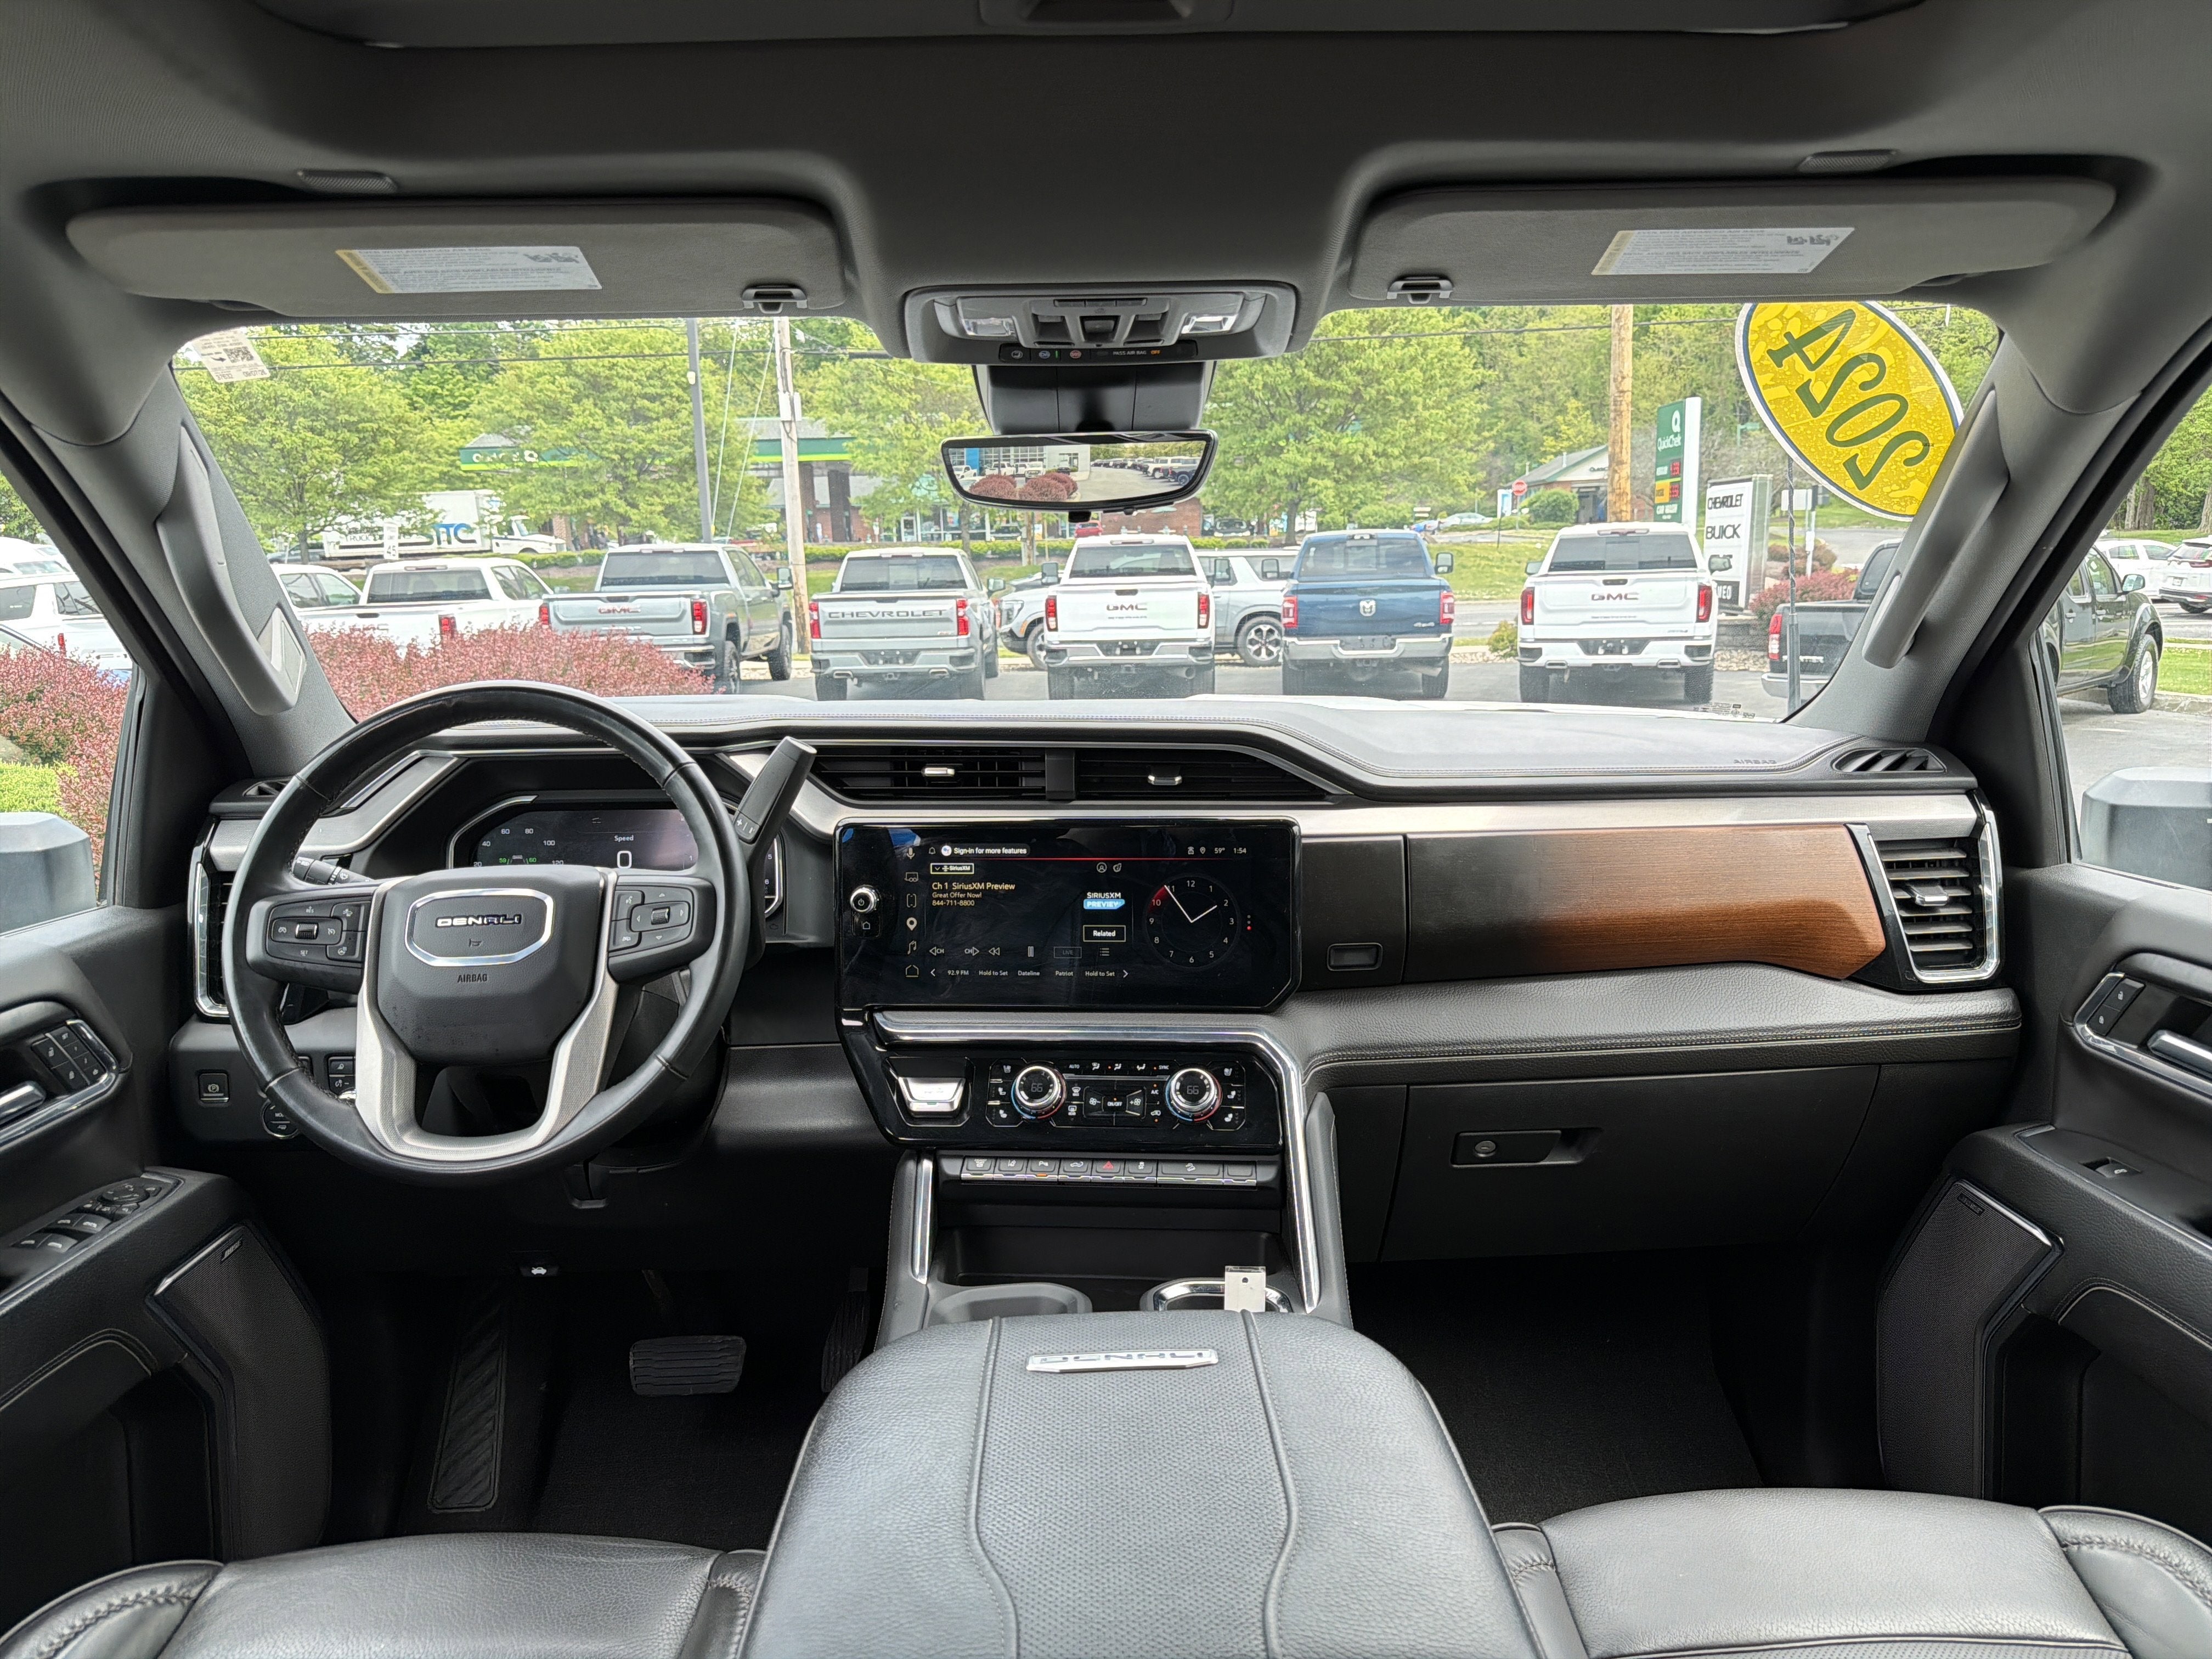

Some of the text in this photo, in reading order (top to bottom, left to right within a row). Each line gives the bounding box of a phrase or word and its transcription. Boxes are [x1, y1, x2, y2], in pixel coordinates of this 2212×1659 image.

[1657, 433, 1681, 452] QuickChek
[1707, 494, 1743, 510] CHEVROLET
[1706, 523, 1741, 540] BUICK
[386, 545, 397, 557] 45
[1592, 592, 1640, 601] GMC
[598, 605, 641, 614] GMC
[1106, 603, 1148, 611] GMC
[828, 609, 947, 619] CHEVROLET
[953, 847, 975, 855] Sign-in
[436, 914, 522, 928] DENALI
[457, 973, 488, 983] AIRBAG
[1031, 1083, 1043, 1092] 66
[1187, 1085, 1199, 1095] 66
